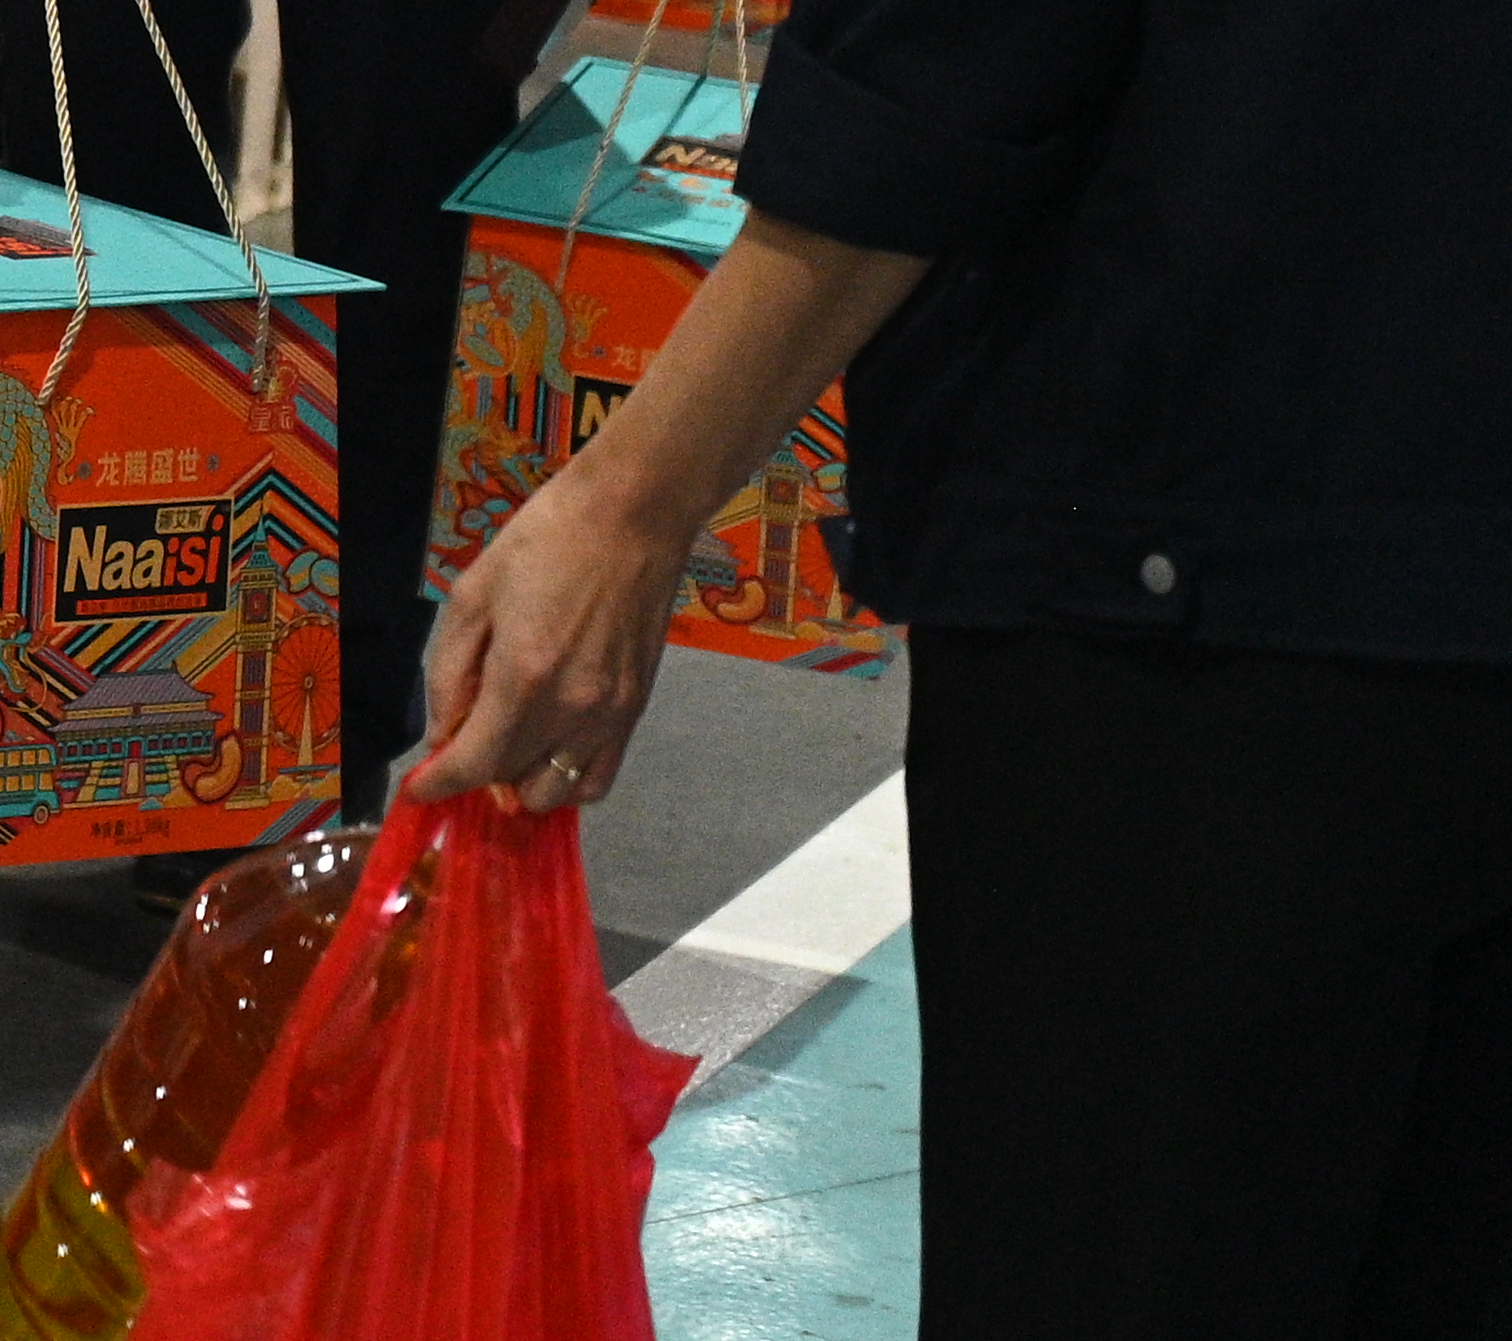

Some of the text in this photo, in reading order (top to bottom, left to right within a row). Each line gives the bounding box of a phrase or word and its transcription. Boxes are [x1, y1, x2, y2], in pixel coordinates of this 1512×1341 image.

[96, 447, 202, 488] 龙腾盛世
[63, 514, 225, 593] Naaisi
